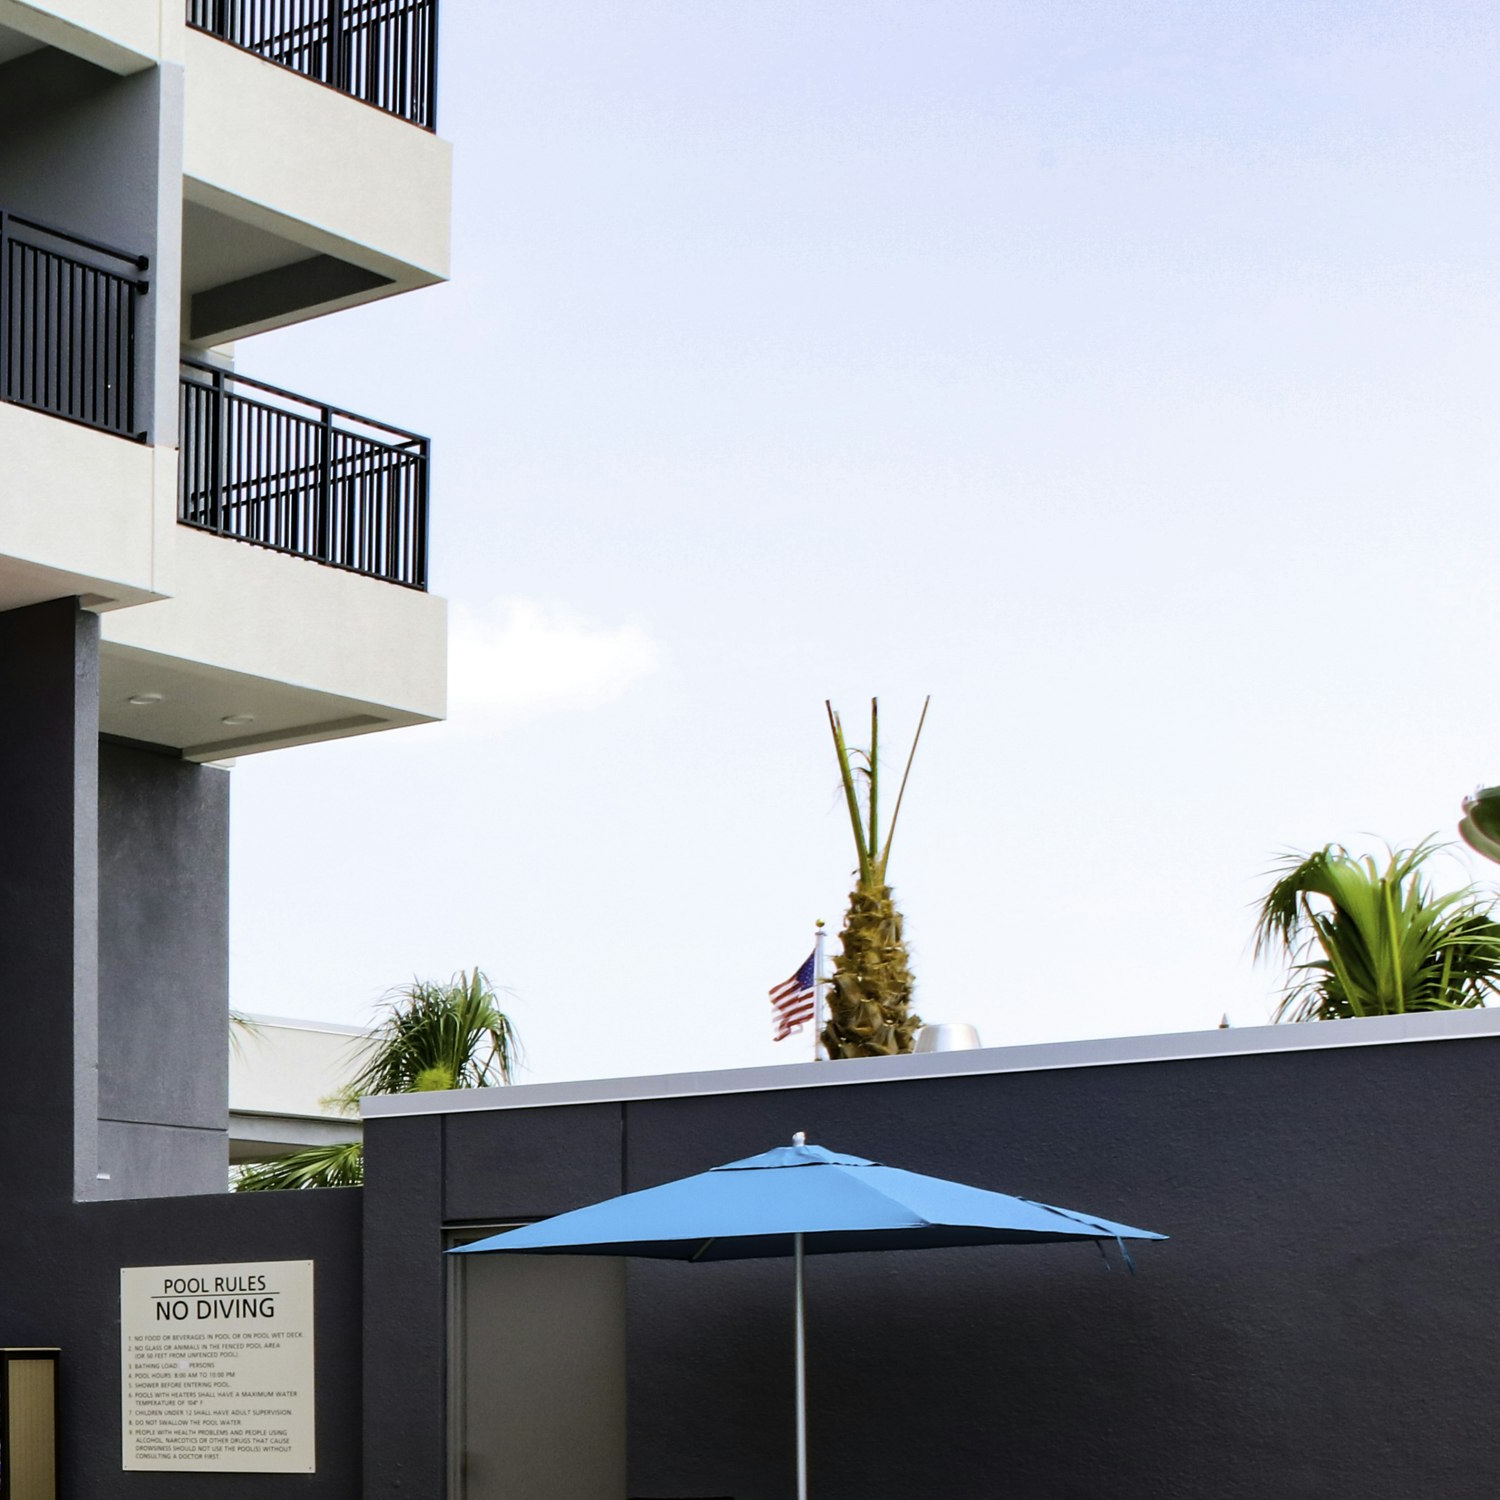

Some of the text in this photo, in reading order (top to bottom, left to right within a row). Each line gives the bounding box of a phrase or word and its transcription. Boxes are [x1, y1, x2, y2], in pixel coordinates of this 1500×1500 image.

[164, 1276, 266, 1294] POOL RULES
[156, 1298, 274, 1320] NO DIVING
